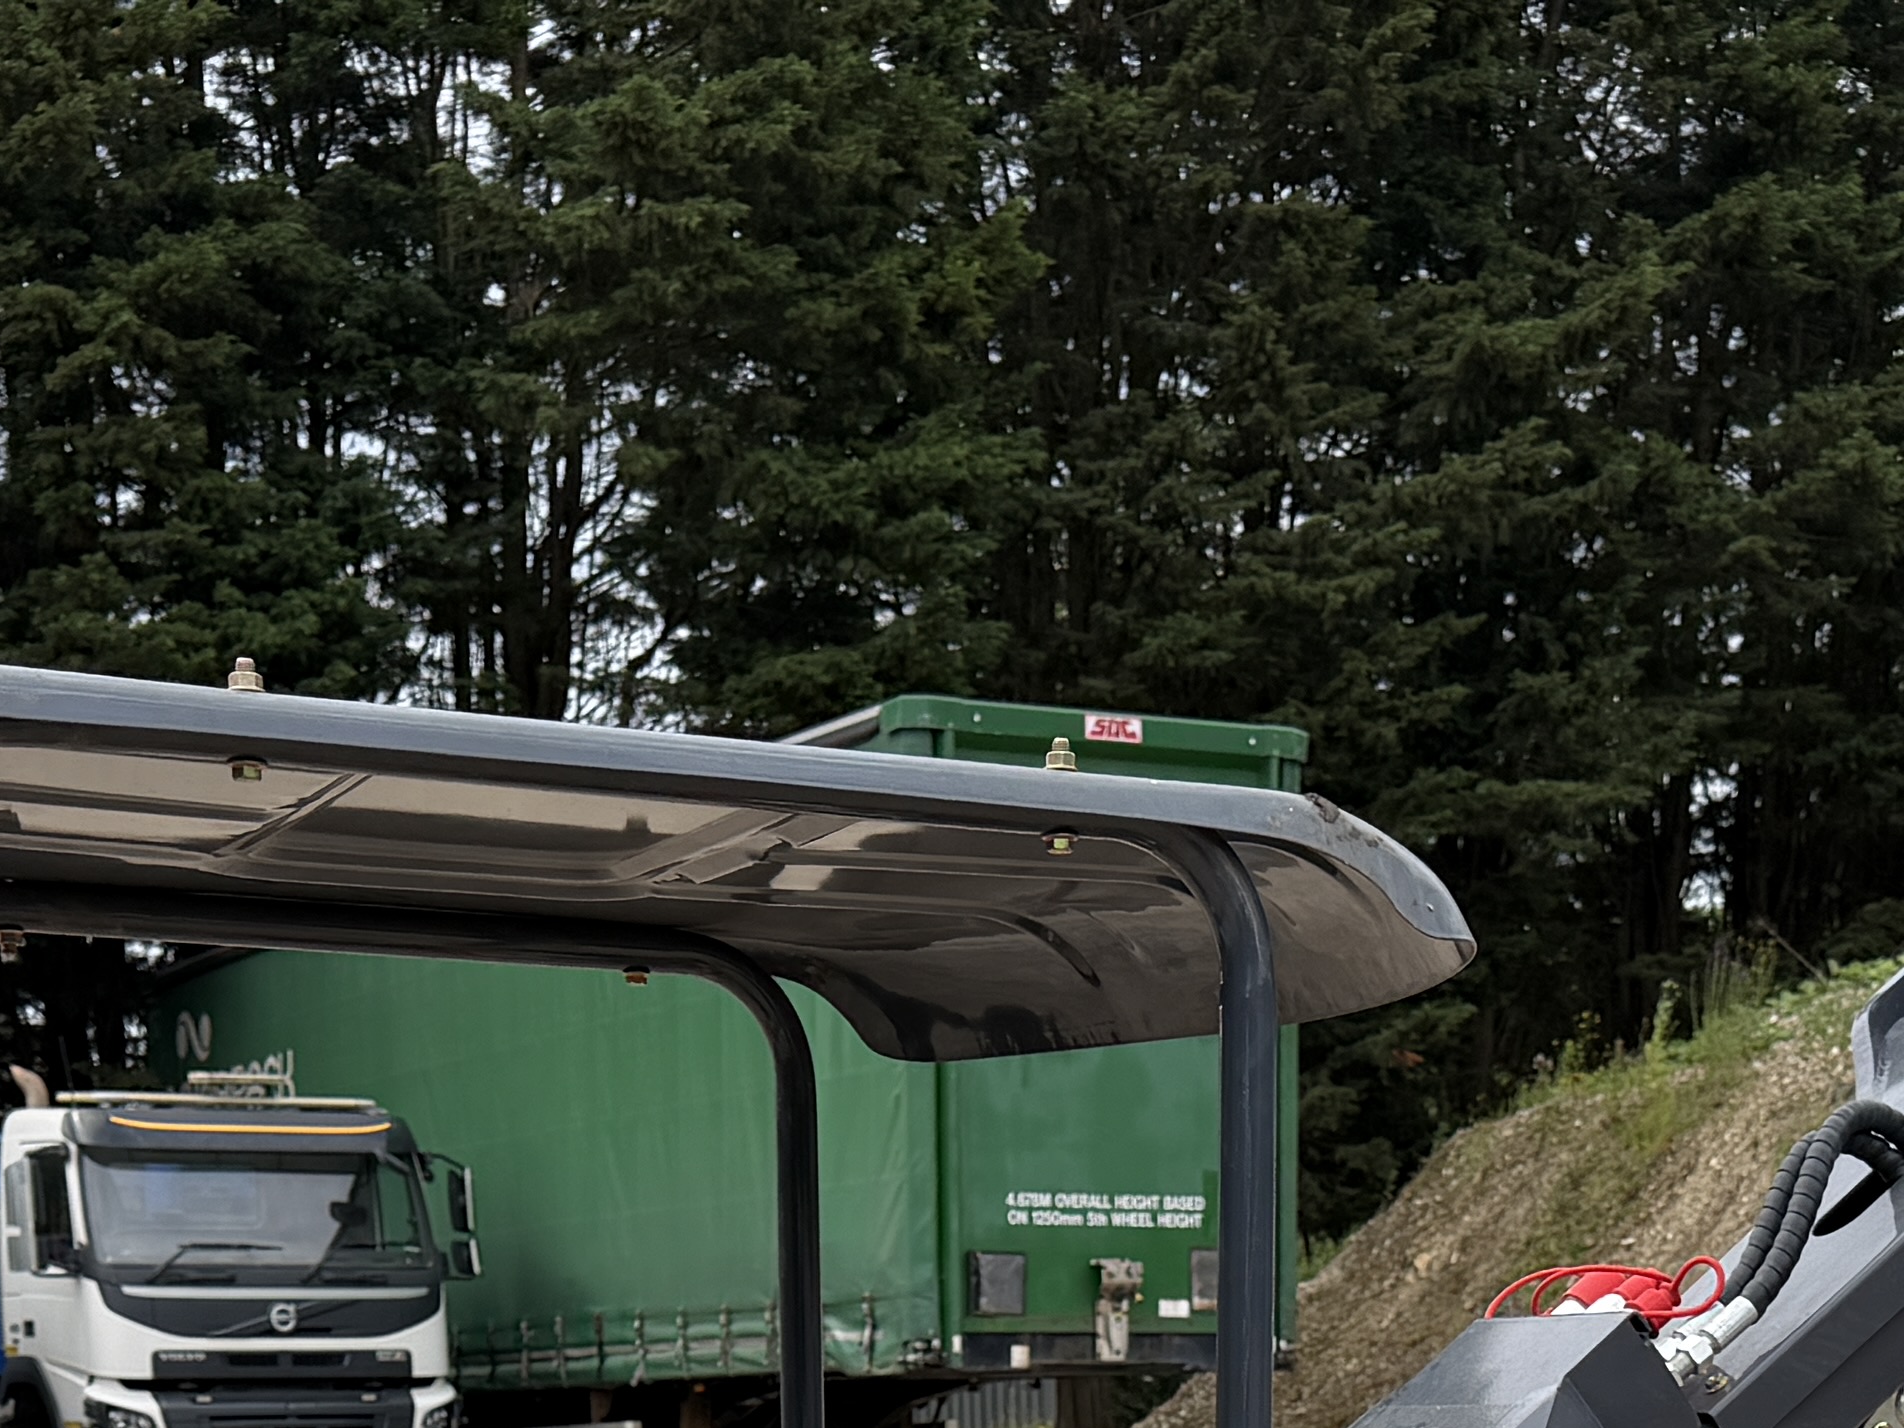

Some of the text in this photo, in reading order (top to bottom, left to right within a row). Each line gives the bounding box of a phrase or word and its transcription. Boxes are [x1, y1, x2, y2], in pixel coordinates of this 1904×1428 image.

[1054, 1192, 1113, 1210] OVERALL
[1114, 1194, 1161, 1210] HEIGHT
[1163, 1195, 1206, 1211] BASED
[1007, 1209, 1029, 1226] ON
[1110, 1211, 1155, 1228] WHEEL
[1157, 1212, 1204, 1229] HEIGHT
